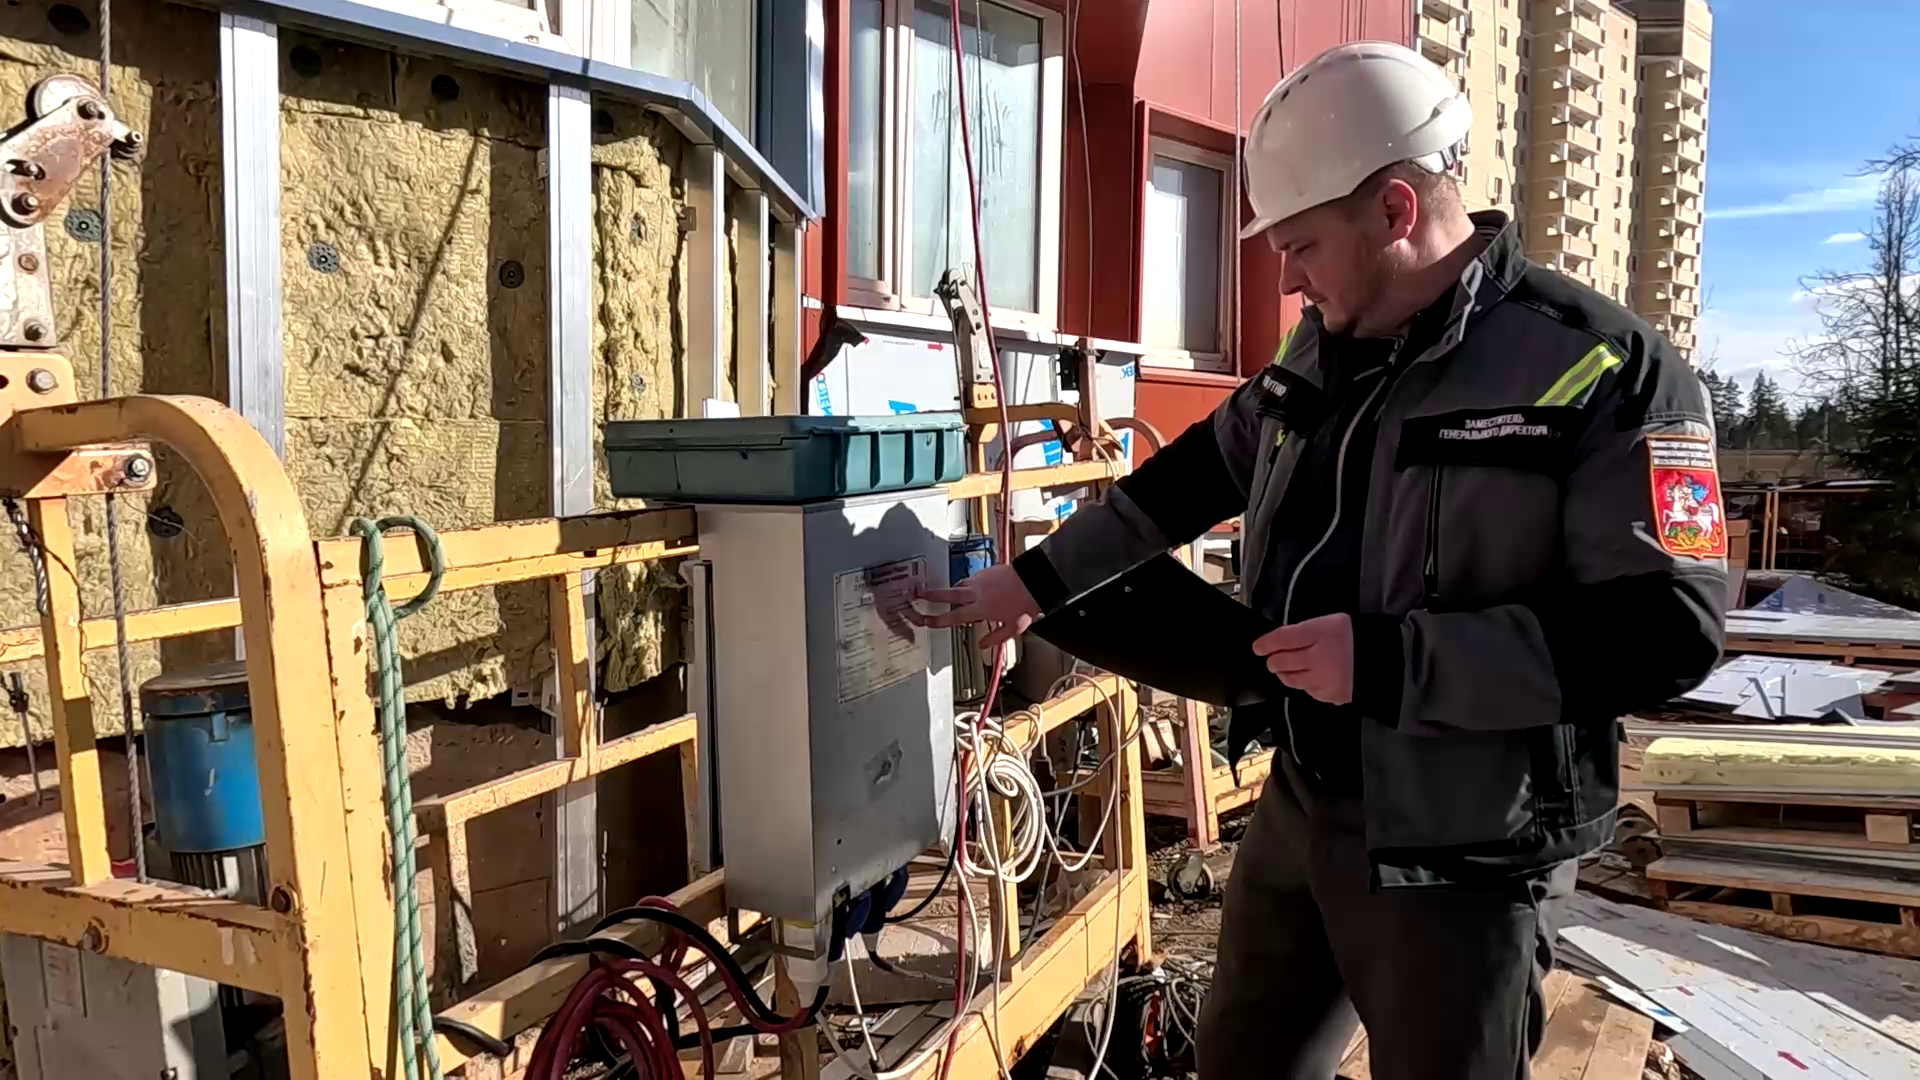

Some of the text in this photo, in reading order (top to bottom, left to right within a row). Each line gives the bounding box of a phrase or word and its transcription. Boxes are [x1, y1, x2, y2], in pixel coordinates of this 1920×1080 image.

[1465, 413, 1525, 429] ЗАМЕСТИТЕЛЬ
[1439, 425, 1548, 440] ГЕНЕРАЛЬНОГО ДИРЕКТОРА
